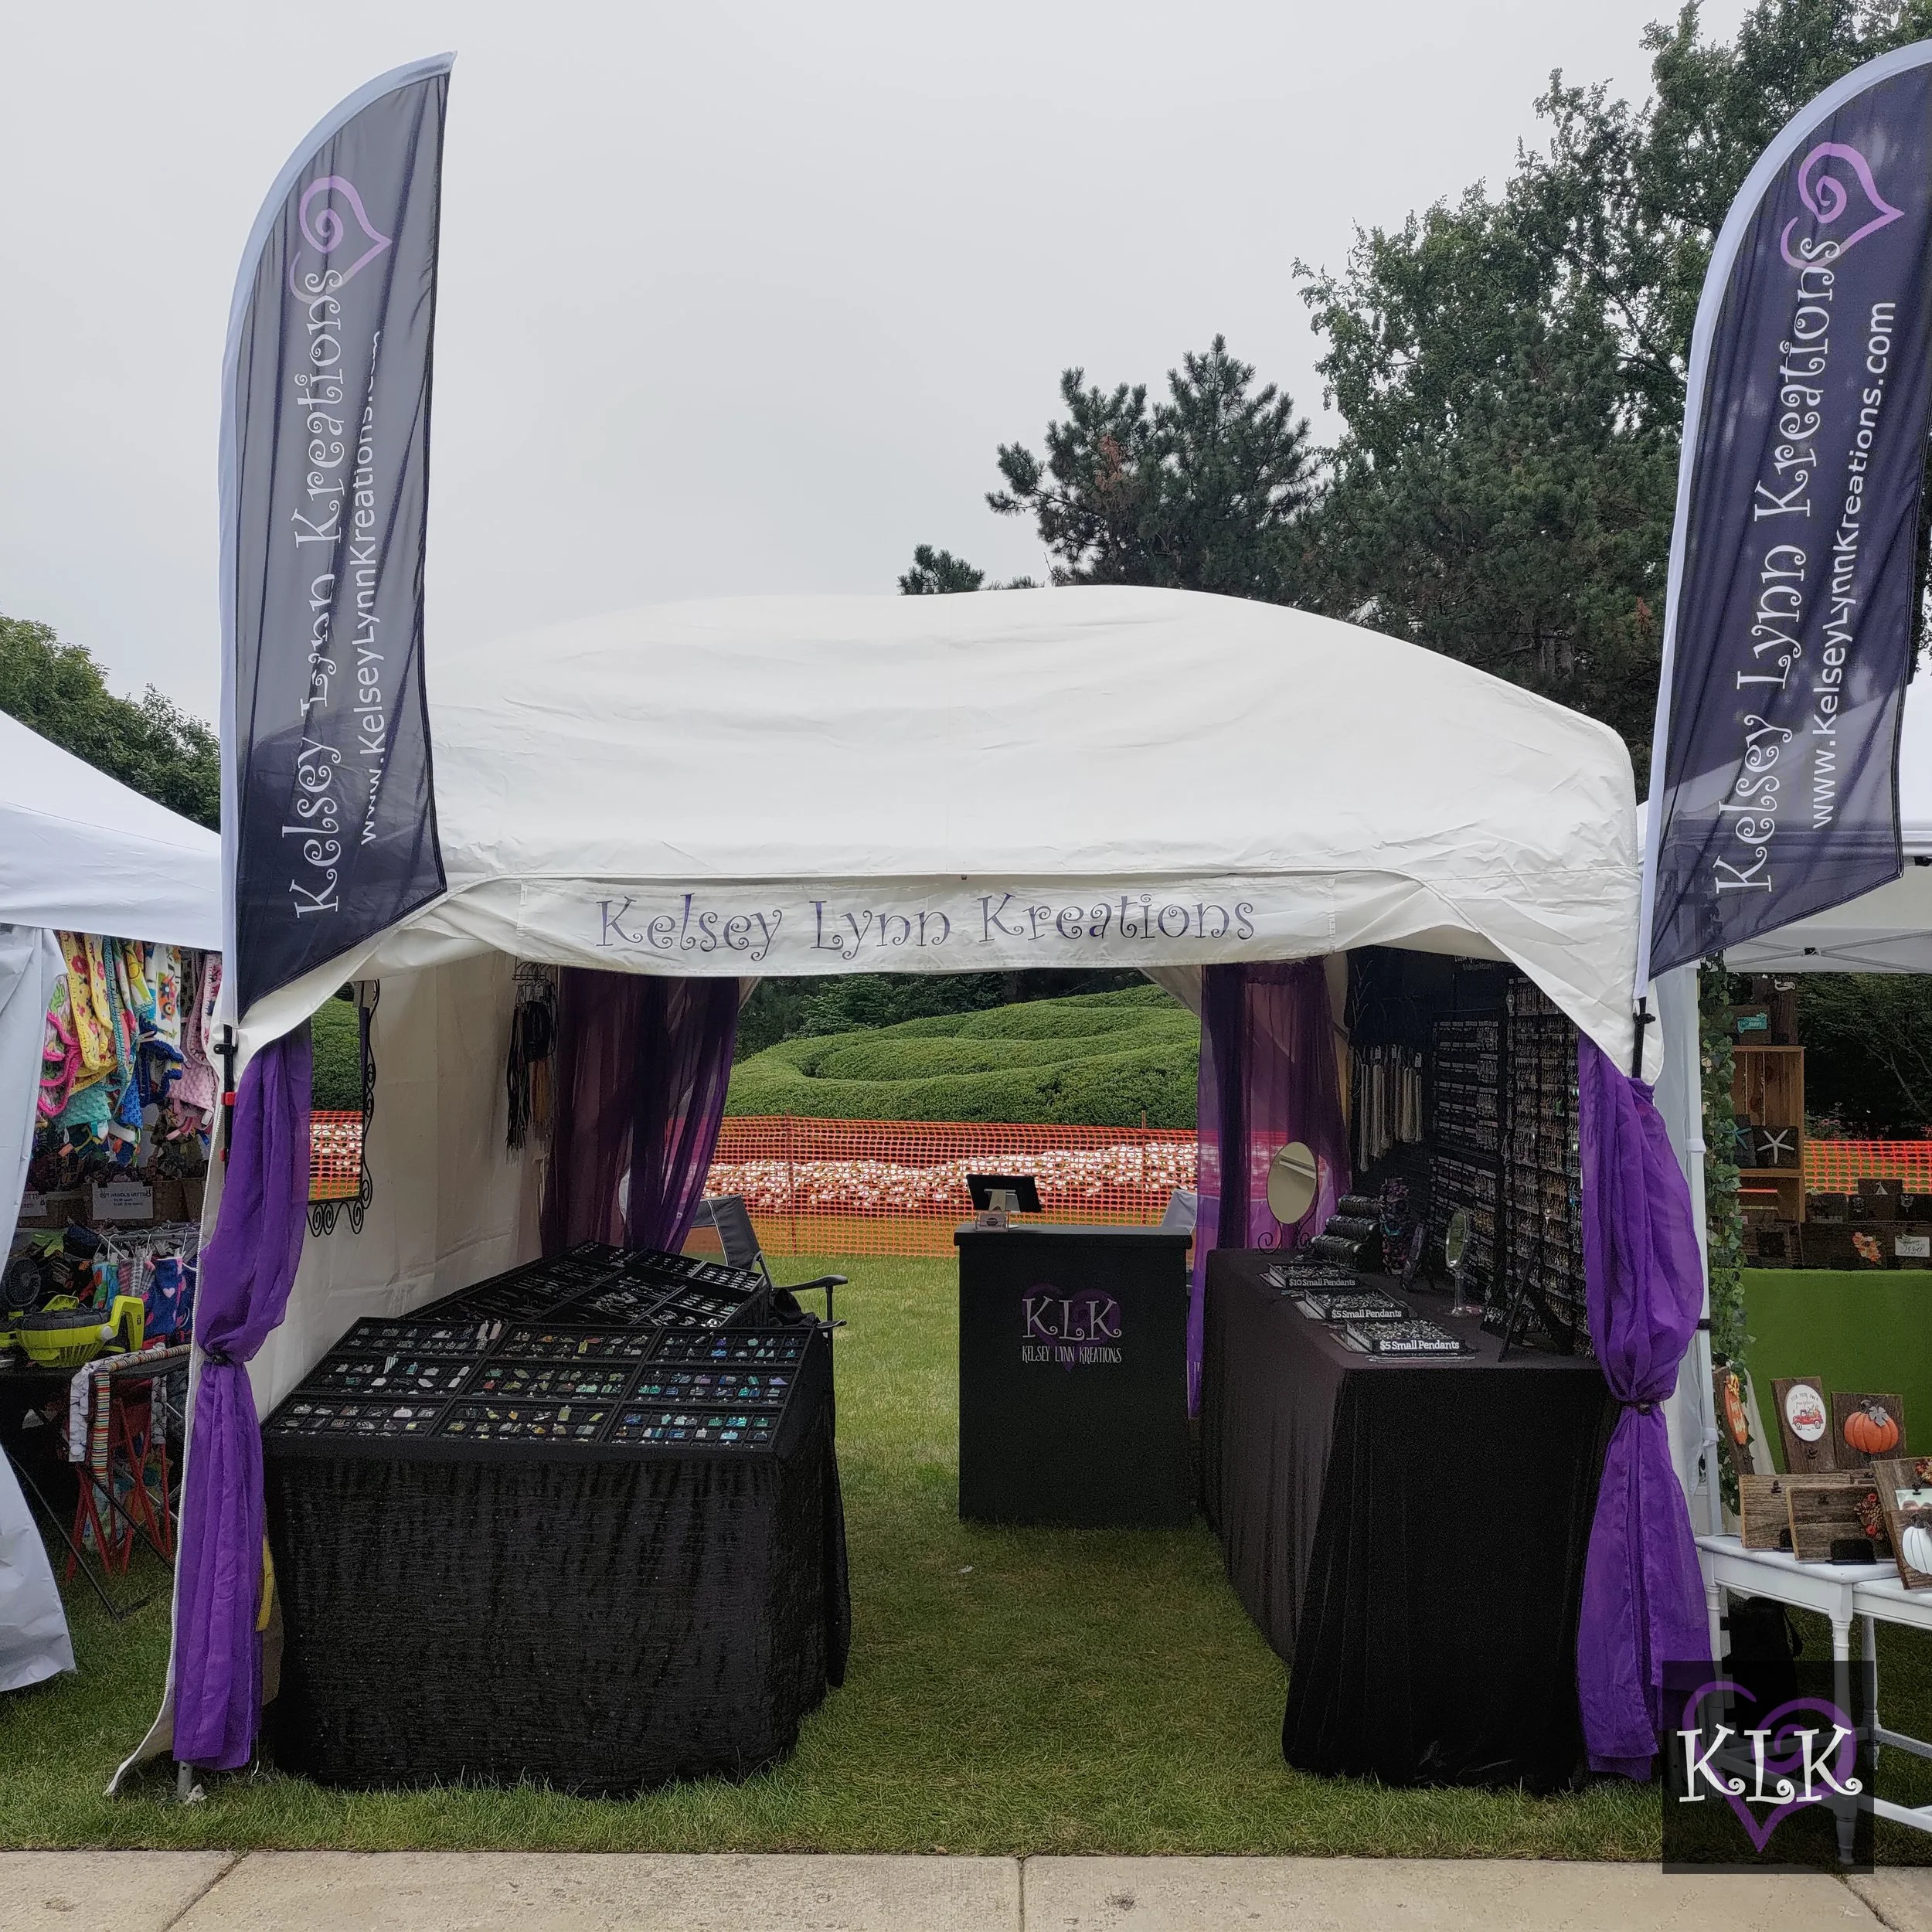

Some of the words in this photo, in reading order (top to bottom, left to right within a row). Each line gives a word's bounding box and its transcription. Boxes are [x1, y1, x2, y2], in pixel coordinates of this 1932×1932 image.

[290, 269, 345, 548] Kreations
[1753, 237, 1841, 522] Kreations
[349, 331, 386, 846] www.KelseyLynnKreations.
[1736, 544, 1807, 689] Lynn
[1812, 302, 1896, 830] www.KelseyLynnKreations.com
[281, 736, 342, 919] Kelsey
[1712, 713, 1793, 893] Kelsey
[594, 893, 783, 962] Kelsey
[809, 900, 951, 959] Lynn
[977, 893, 1255, 944] Kreations
[1022, 1295, 1122, 1341] KLK
[1289, 1278, 1302, 1287] $10
[1302, 1277, 1322, 1286] Small
[1323, 1277, 1355, 1286] Pendants
[1332, 1308, 1342, 1318] $5
[1342, 1308, 1365, 1318] Small
[1365, 1308, 1402, 1318] Pendants
[1379, 1339, 1391, 1351] $5
[1392, 1339, 1417, 1350] Small
[1418, 1339, 1460, 1350] Pendants
[1022, 1345, 1050, 1363] KELSEY
[1055, 1345, 1075, 1362] LYNN
[1079, 1346, 1122, 1365] KREATIONS
